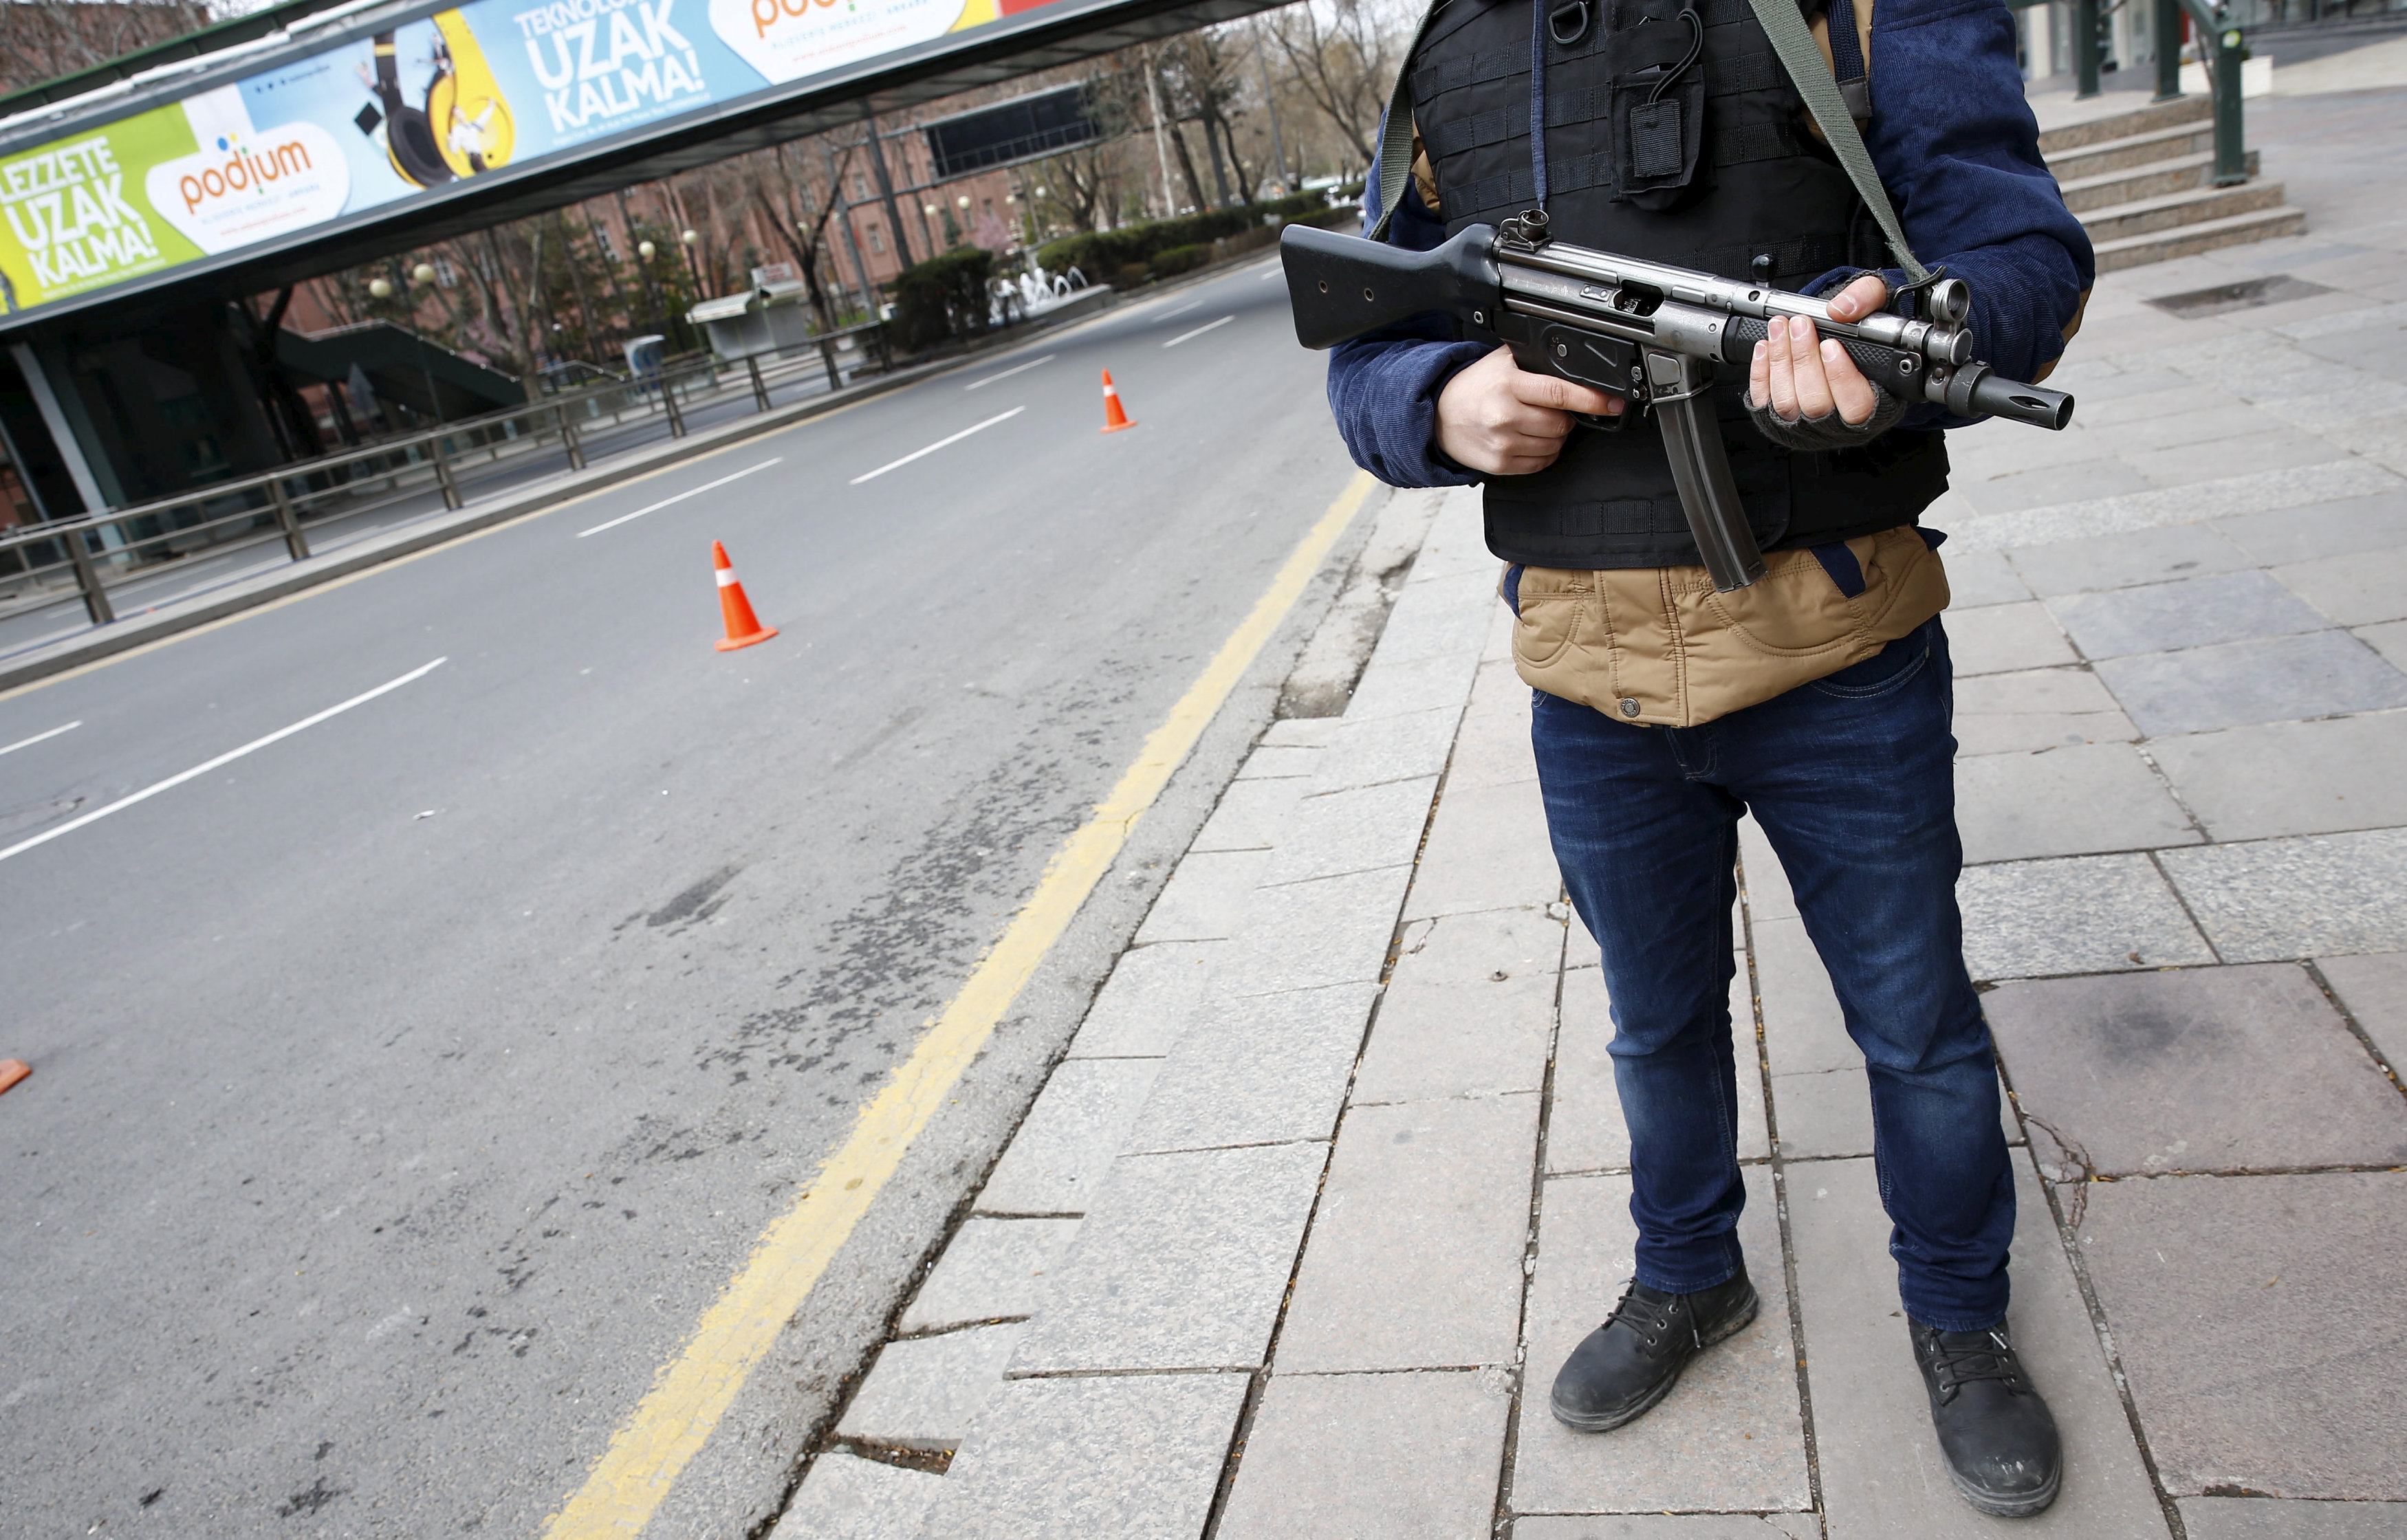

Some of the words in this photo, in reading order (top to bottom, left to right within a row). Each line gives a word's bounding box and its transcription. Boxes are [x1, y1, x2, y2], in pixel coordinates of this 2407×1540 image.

[525, 0, 692, 89] UZAK
[544, 48, 705, 133] KALMA!
[5, 172, 142, 251] UZAK
[180, 142, 312, 216] podium
[27, 220, 159, 288] KALMA!
